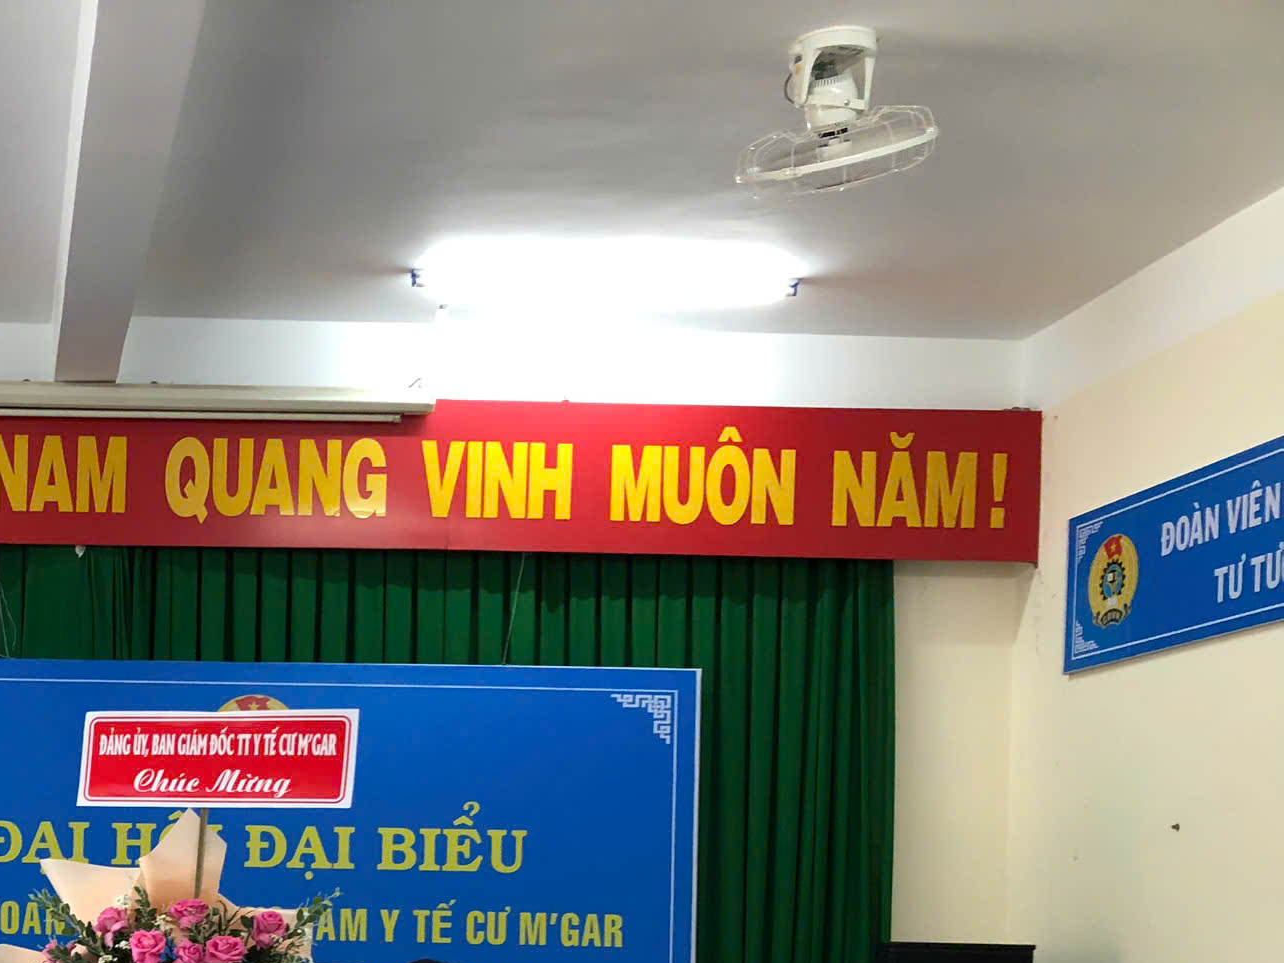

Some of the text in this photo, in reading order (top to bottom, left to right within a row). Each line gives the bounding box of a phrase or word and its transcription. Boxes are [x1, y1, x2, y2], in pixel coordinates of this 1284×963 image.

[164, 436, 387, 524] QUANG
[421, 440, 573, 520] VINH
[610, 426, 796, 526] MUÔN
[1161, 480, 1282, 556] ĐOÀN VIÊN
[1214, 541, 1284, 603] TƯ TƯ
[99, 727, 131, 756] ĐẢNG
[151, 733, 176, 756] BAN
[177, 728, 208, 756] GIÁM
[209, 726, 235, 756] ĐỐC
[236, 733, 252, 756] TT
[253, 733, 262, 756] Y
[263, 726, 280, 756] TẾ
[278, 732, 298, 756] CƯ
[133, 768, 292, 798] Chúc Mừng
[243, 825, 355, 880] ĐẠI
[376, 801, 528, 873] BIỂU
[314, 900, 367, 941] ÂM
[380, 908, 400, 943] Y
[413, 900, 458, 944] TẾ
[465, 906, 511, 945] CƯ
